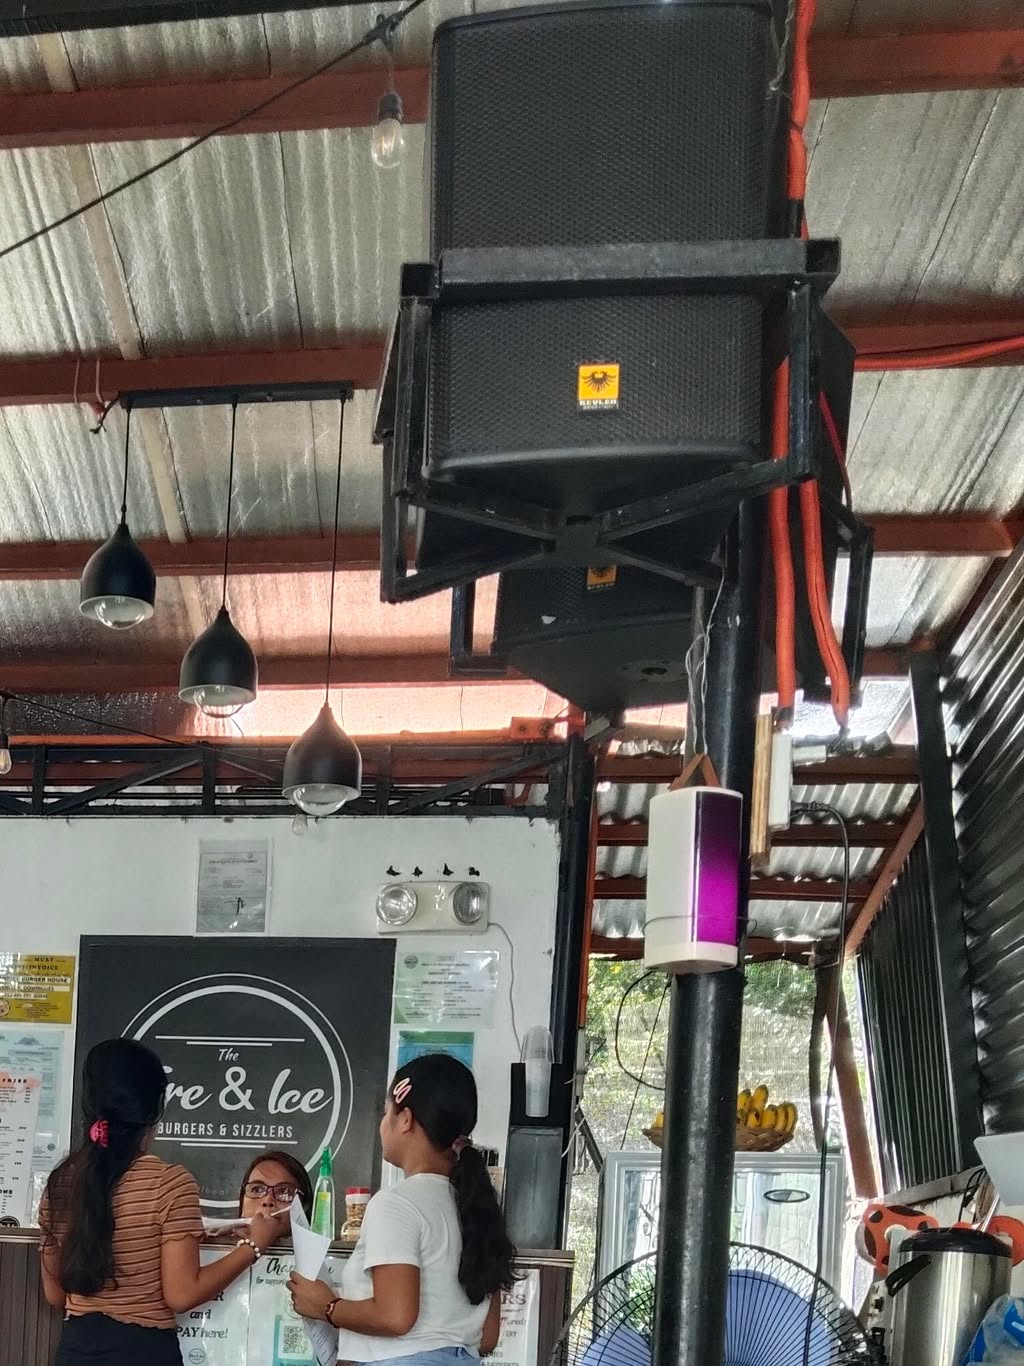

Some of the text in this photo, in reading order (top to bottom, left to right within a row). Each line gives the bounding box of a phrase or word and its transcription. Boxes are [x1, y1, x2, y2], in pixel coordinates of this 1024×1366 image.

[218, 1048, 240, 1062] The
[162, 1065, 334, 1115] re & Ice
[157, 1121, 294, 1138] BURGERS & SIZZLERS
[189, 1309, 212, 1320] and
[176, 1326, 229, 1339] PAY here!
